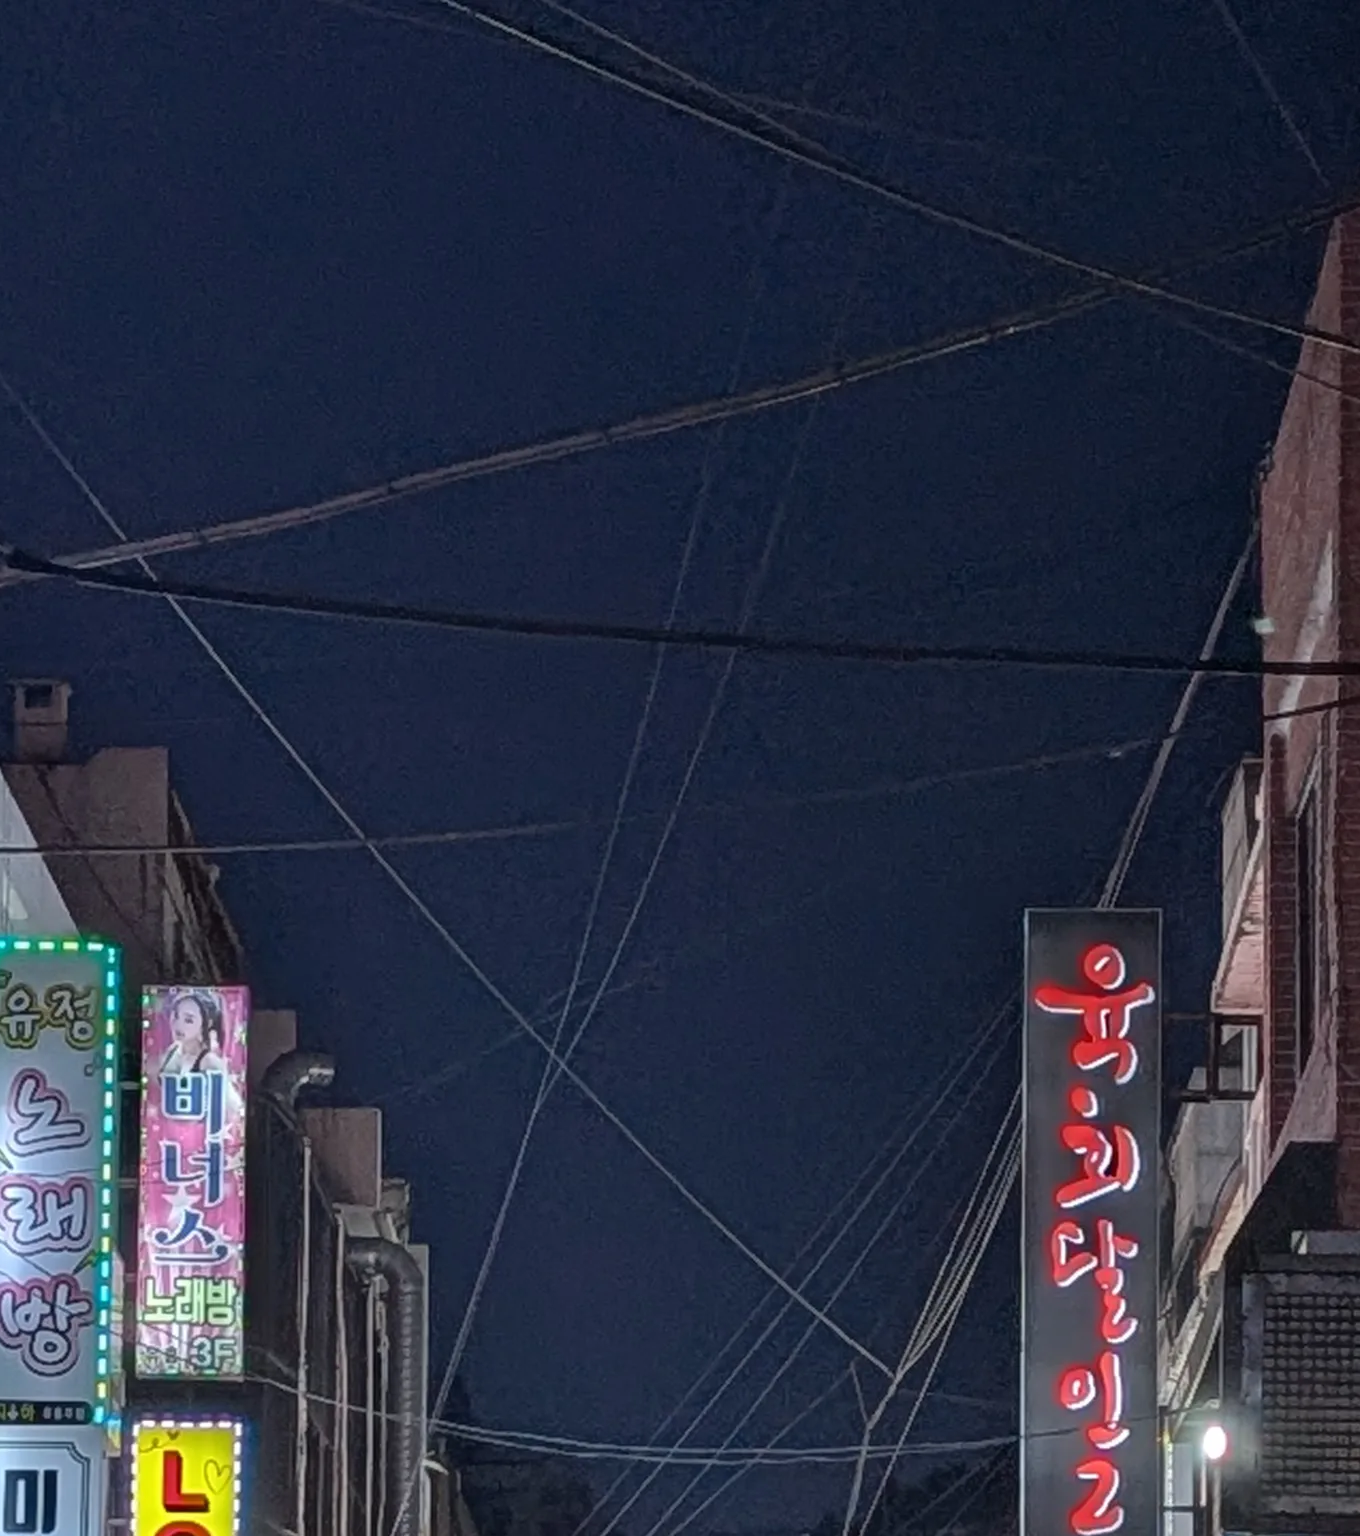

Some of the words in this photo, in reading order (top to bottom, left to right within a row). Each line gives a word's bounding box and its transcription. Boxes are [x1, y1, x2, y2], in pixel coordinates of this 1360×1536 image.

[0, 984, 99, 1049] 유정
[155, 1070, 230, 1264] 비너스
[142, 1276, 239, 1325] 노래방
[192, 1335, 237, 1366] 3F
